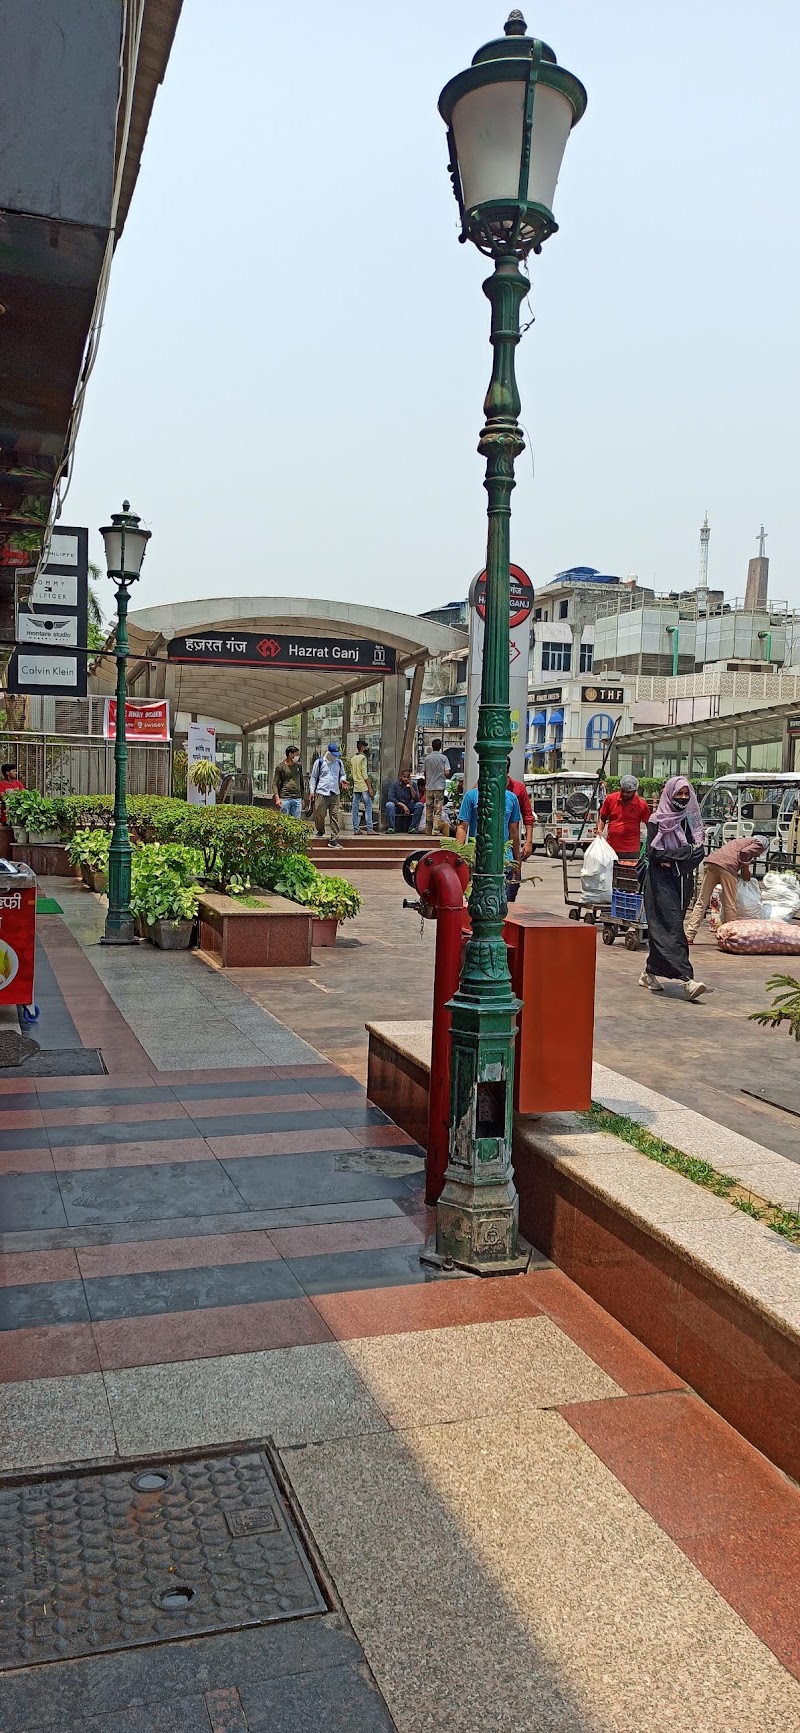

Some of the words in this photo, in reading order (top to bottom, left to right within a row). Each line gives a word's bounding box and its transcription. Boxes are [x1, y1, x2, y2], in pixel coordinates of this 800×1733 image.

[38, 579, 65, 587] OMMY
[510, 599, 530, 608] GANJ
[184, 638, 223, 652] हज़रत
[225, 637, 248, 653] गंज
[288, 643, 329, 658] Hazrat
[332, 646, 359, 663] Ganj
[21, 665, 51, 675] Calvin
[52, 666, 74, 676] Klein
[600, 689, 622, 700] THF
